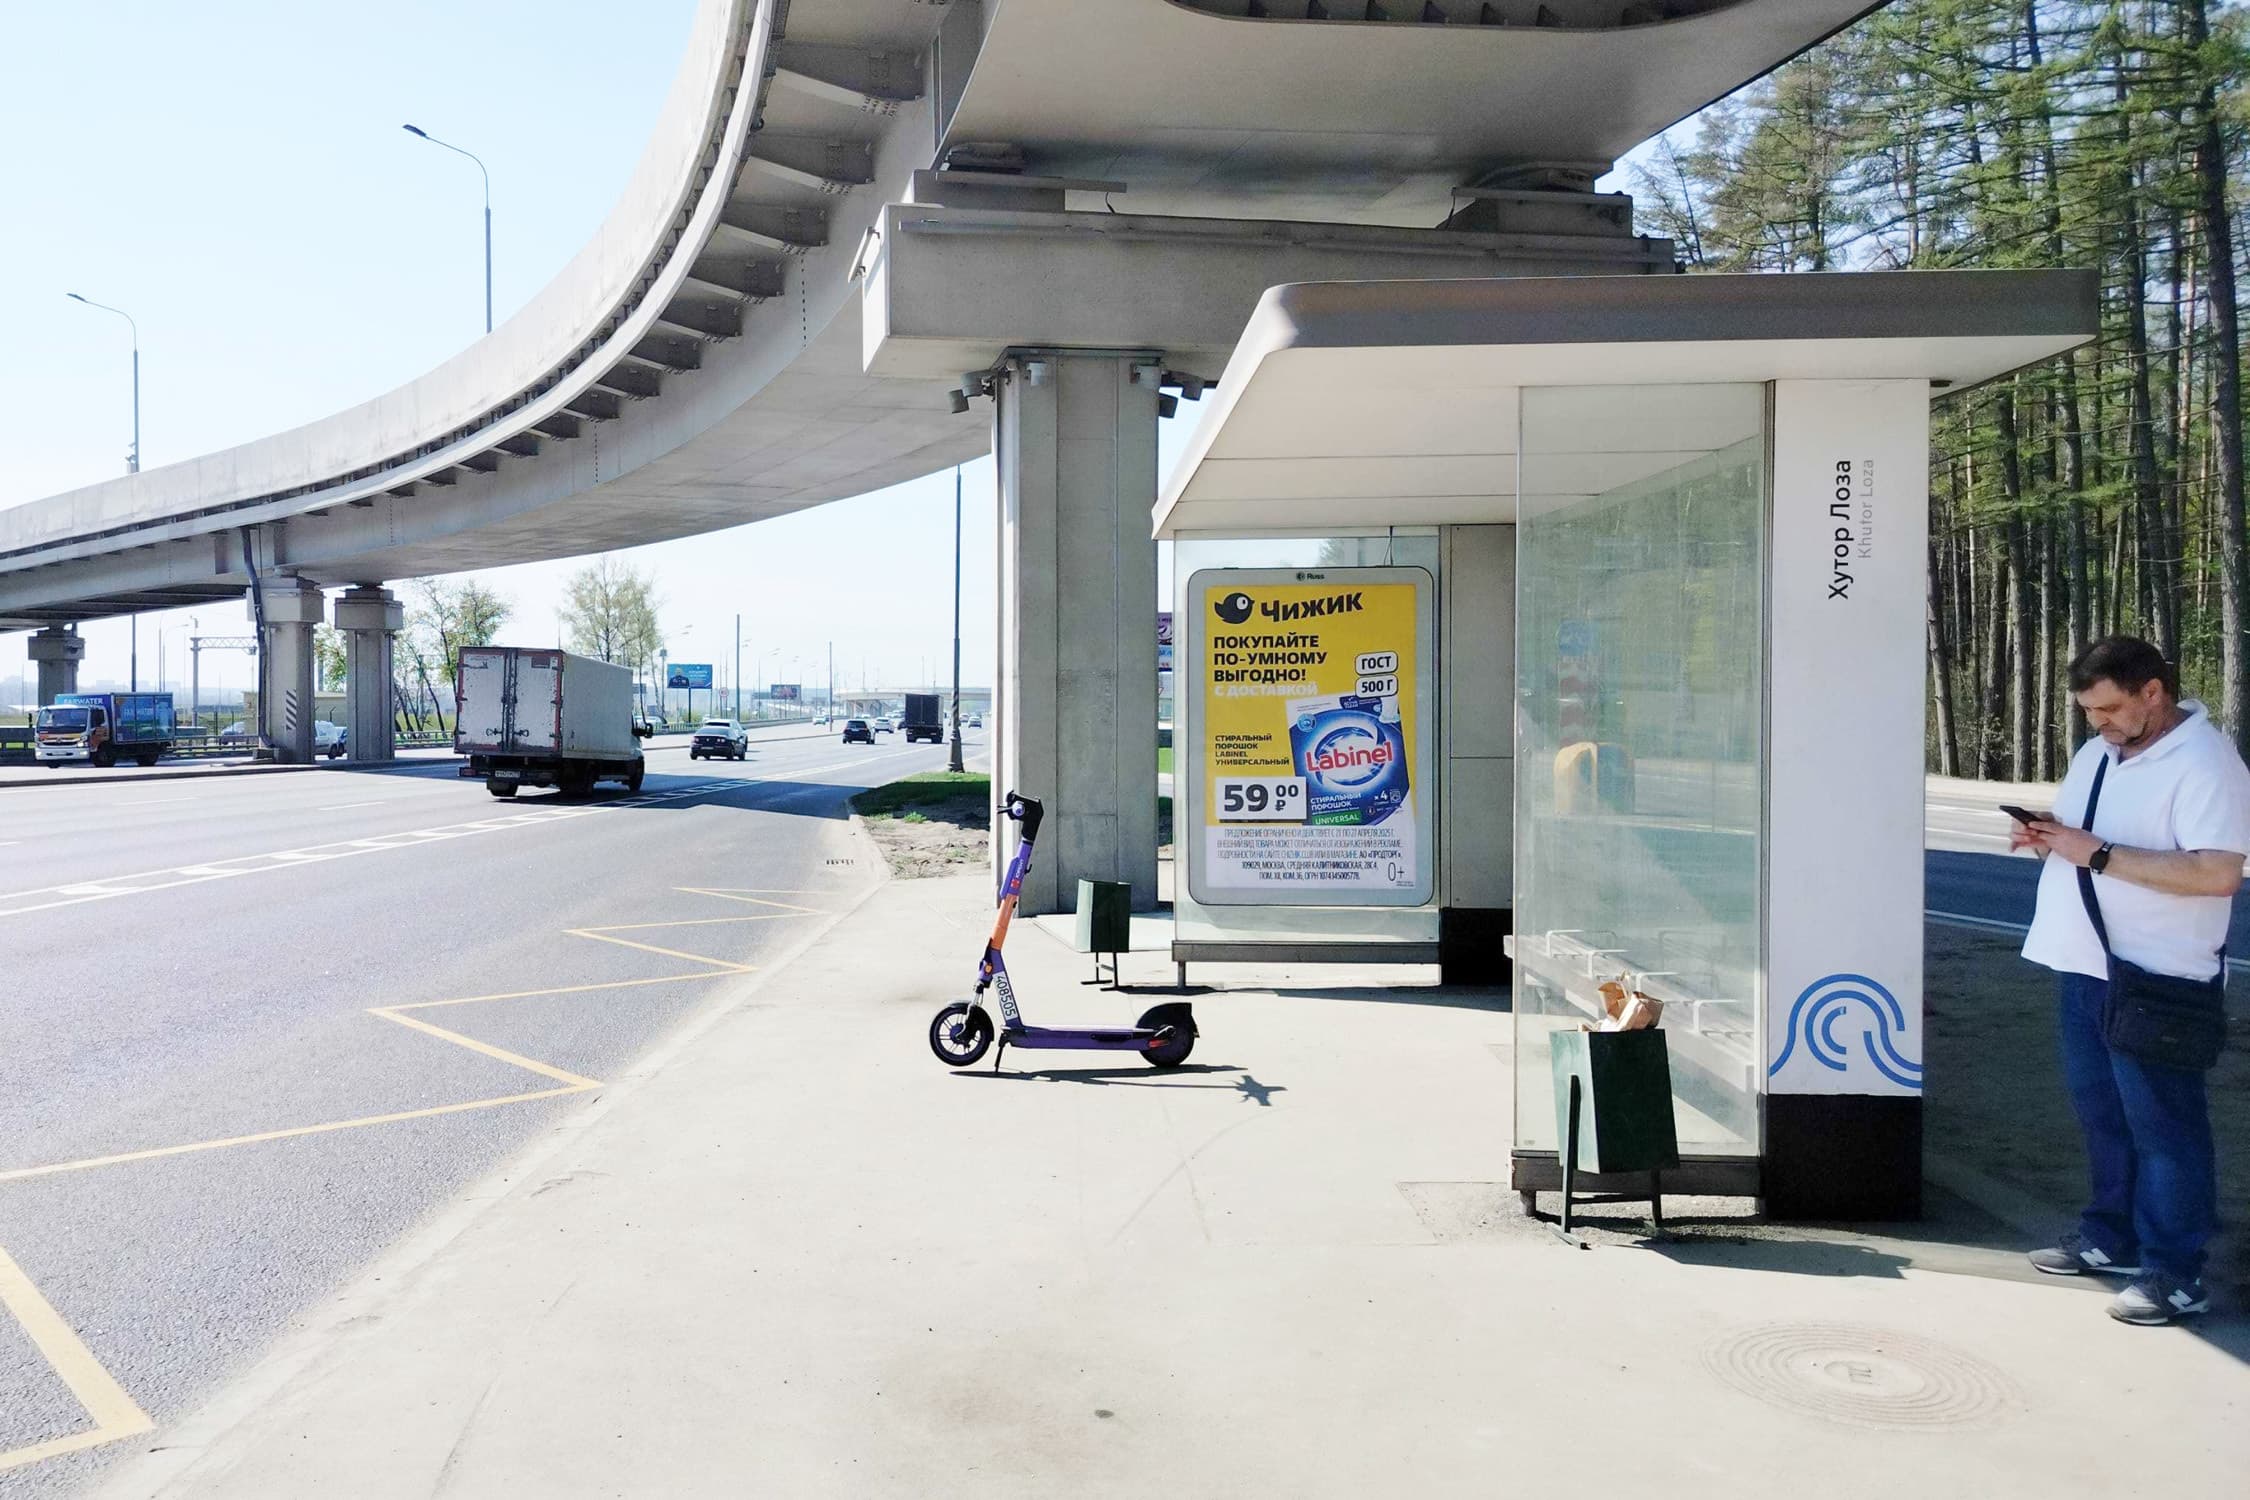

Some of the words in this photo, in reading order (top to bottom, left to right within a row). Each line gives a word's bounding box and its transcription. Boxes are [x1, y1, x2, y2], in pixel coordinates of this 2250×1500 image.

[1859, 459, 1874, 497] Loza
[1829, 460, 1851, 520] Лоза
[1857, 502, 1873, 559] Khutor
[1828, 527, 1855, 600] Хутор
[1214, 632, 1319, 649] ПОКУПАЙТЕ
[1214, 652, 1327, 666] ПО-УМНОМУ
[1361, 655, 1392, 670] ГОСТ
[1214, 669, 1306, 684] ВЫГОДНО!
[1227, 681, 1318, 697] ДОСТАВКОЙ
[1361, 680, 1384, 693] 500
[1215, 733, 1272, 741] СТИРАЛЬНЫЙ
[1215, 757, 1289, 765] УНИВЕРСАЛЬНЫЙ
[1305, 741, 1393, 772] Labinel
[1224, 784, 1268, 812] 59
[1275, 784, 1298, 797] 00
[1310, 792, 1361, 803] СТИРАЛЬНЫЙ
[1311, 801, 1352, 810] ПОРОШОК
[1315, 814, 1359, 825] UNIVERSAL
[1388, 862, 1405, 881] 0+
[995, 975, 1016, 1017] 408505
